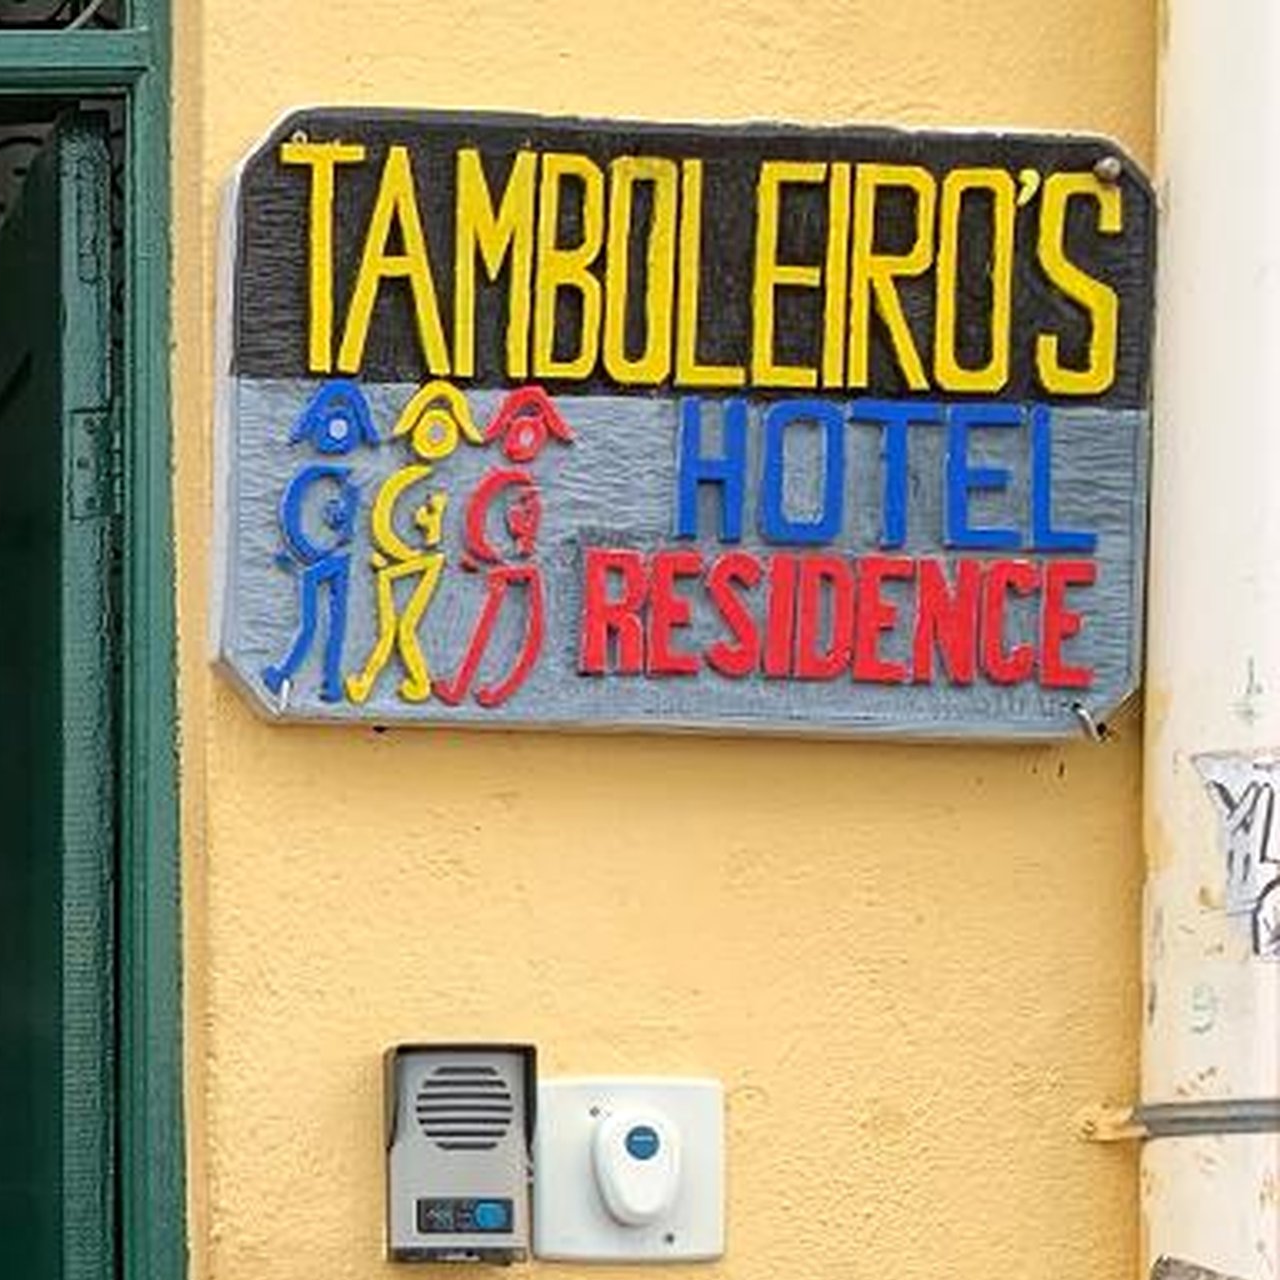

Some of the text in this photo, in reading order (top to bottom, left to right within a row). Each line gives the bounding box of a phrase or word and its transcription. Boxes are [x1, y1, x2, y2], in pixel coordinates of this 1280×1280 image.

[280, 143, 1122, 394] TAMBOLEIRO'S
[678, 400, 1097, 551] HOTEL
[579, 548, 1096, 688] RESIDENCE
